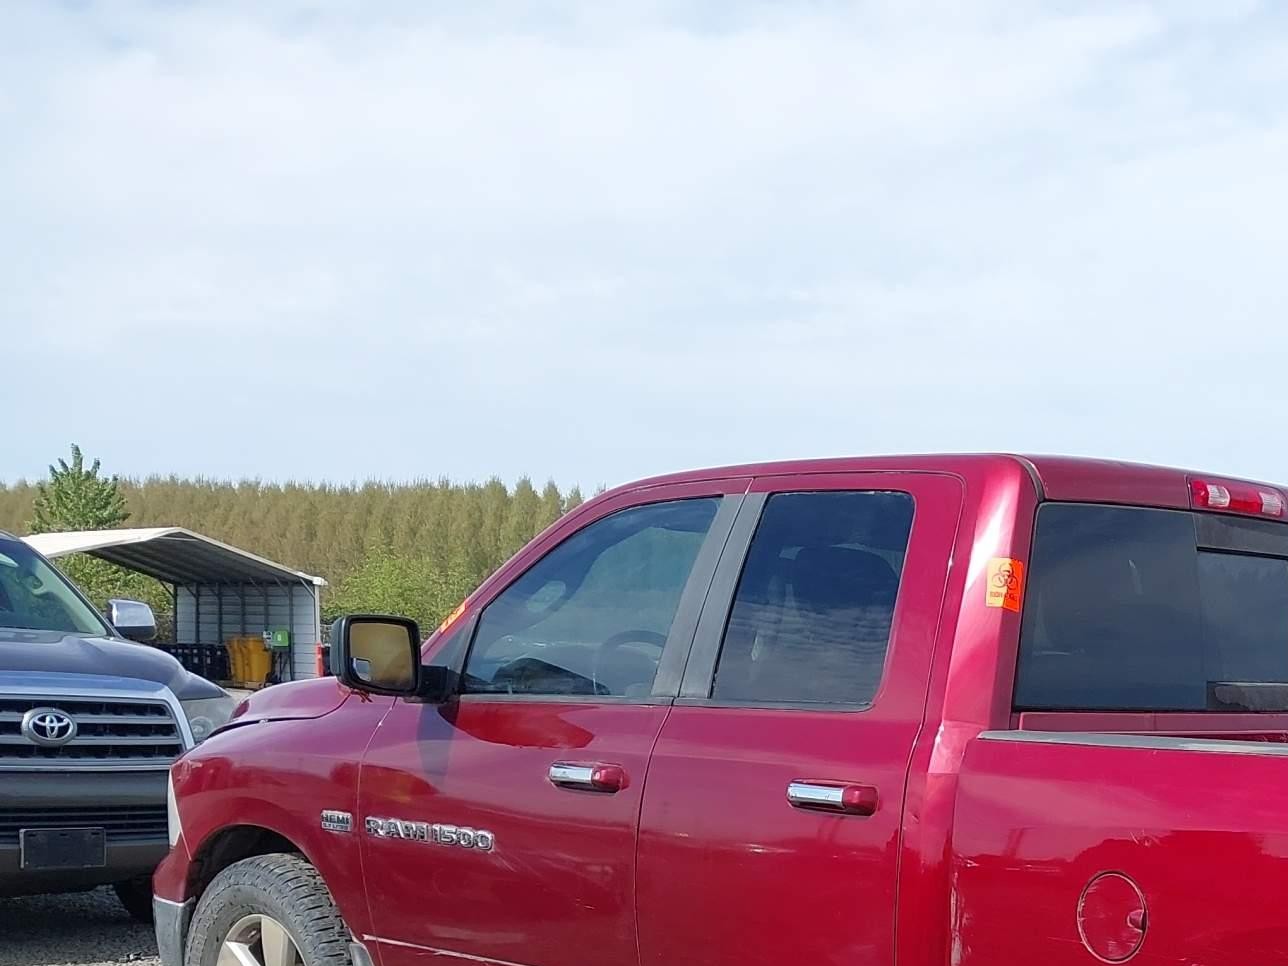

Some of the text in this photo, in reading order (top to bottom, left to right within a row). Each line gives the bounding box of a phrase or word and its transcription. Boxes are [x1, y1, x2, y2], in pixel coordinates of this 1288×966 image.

[321, 813, 350, 825] HEMI
[365, 816, 495, 853] RAM 1500
